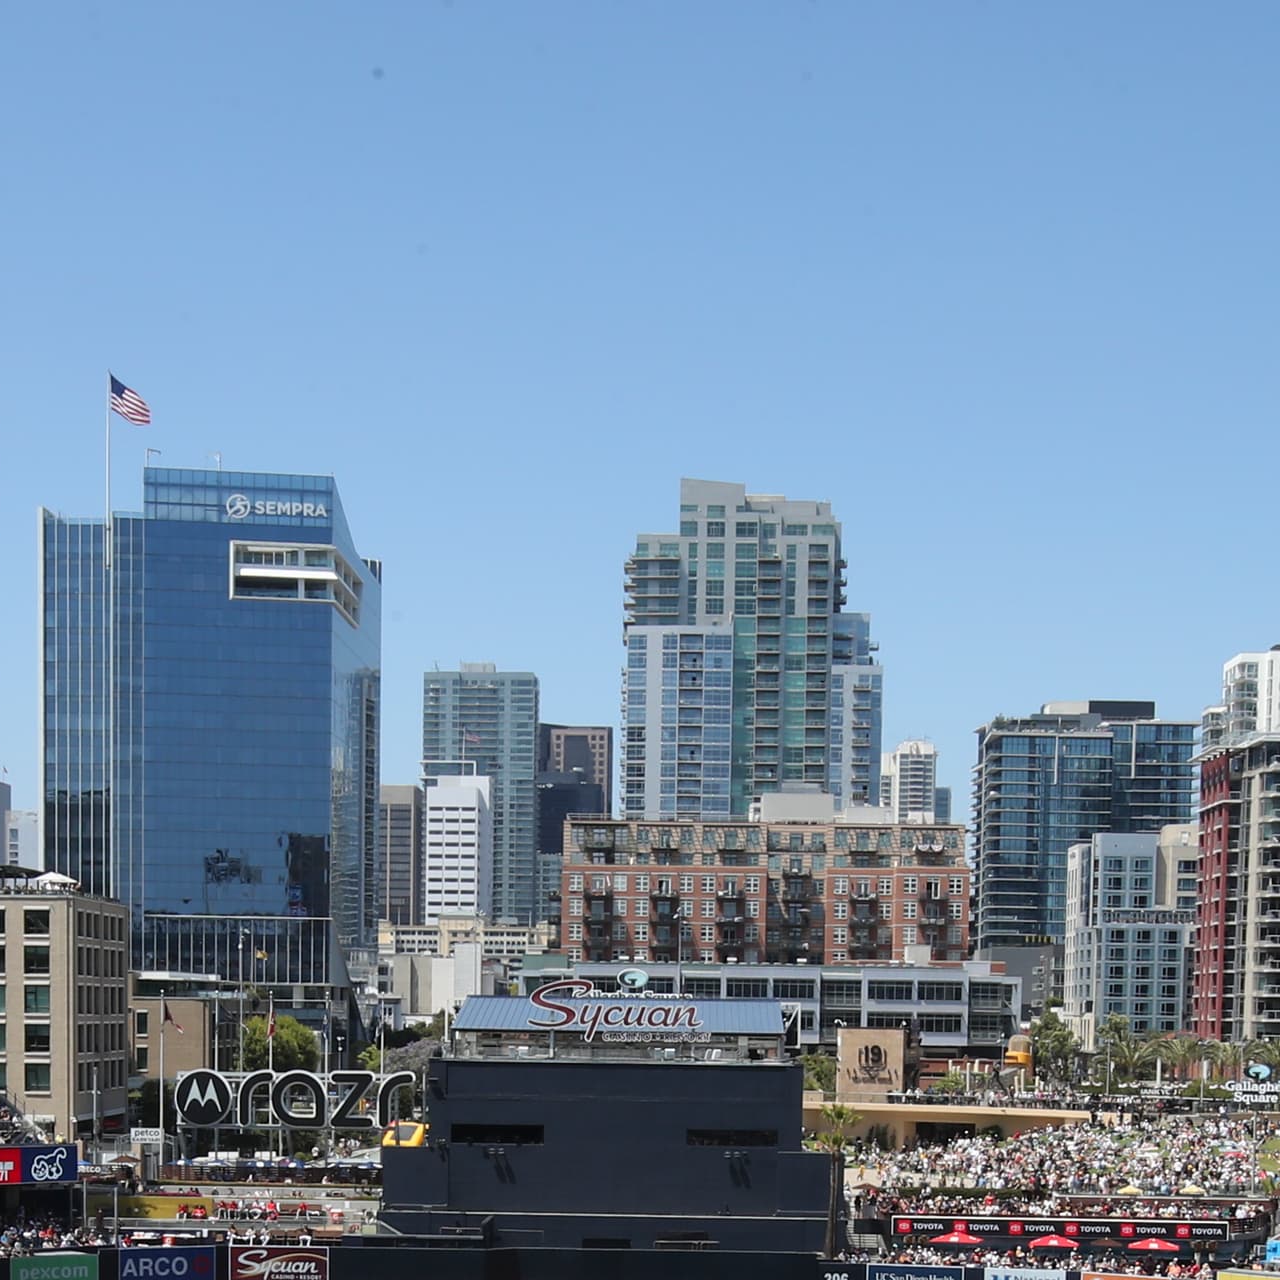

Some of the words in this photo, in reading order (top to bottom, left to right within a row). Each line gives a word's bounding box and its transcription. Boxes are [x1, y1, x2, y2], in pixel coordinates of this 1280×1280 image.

[254, 501, 327, 517] SEMPRA
[527, 978, 704, 1042] Sycuan
[238, 1070, 415, 1127] razr
[1234, 1092, 1278, 1104] Square
[913, 1222, 943, 1231] TOYOTA
[968, 1223, 999, 1232] TOYOTA
[1024, 1224, 1054, 1232] TOYOTA
[1080, 1225, 1110, 1233] TOYOTA
[1136, 1226, 1166, 1235] TOYOTA
[1192, 1227, 1222, 1236] TOYOTA
[123, 1257, 188, 1277] ARCO
[236, 1250, 318, 1280] Sycuan
